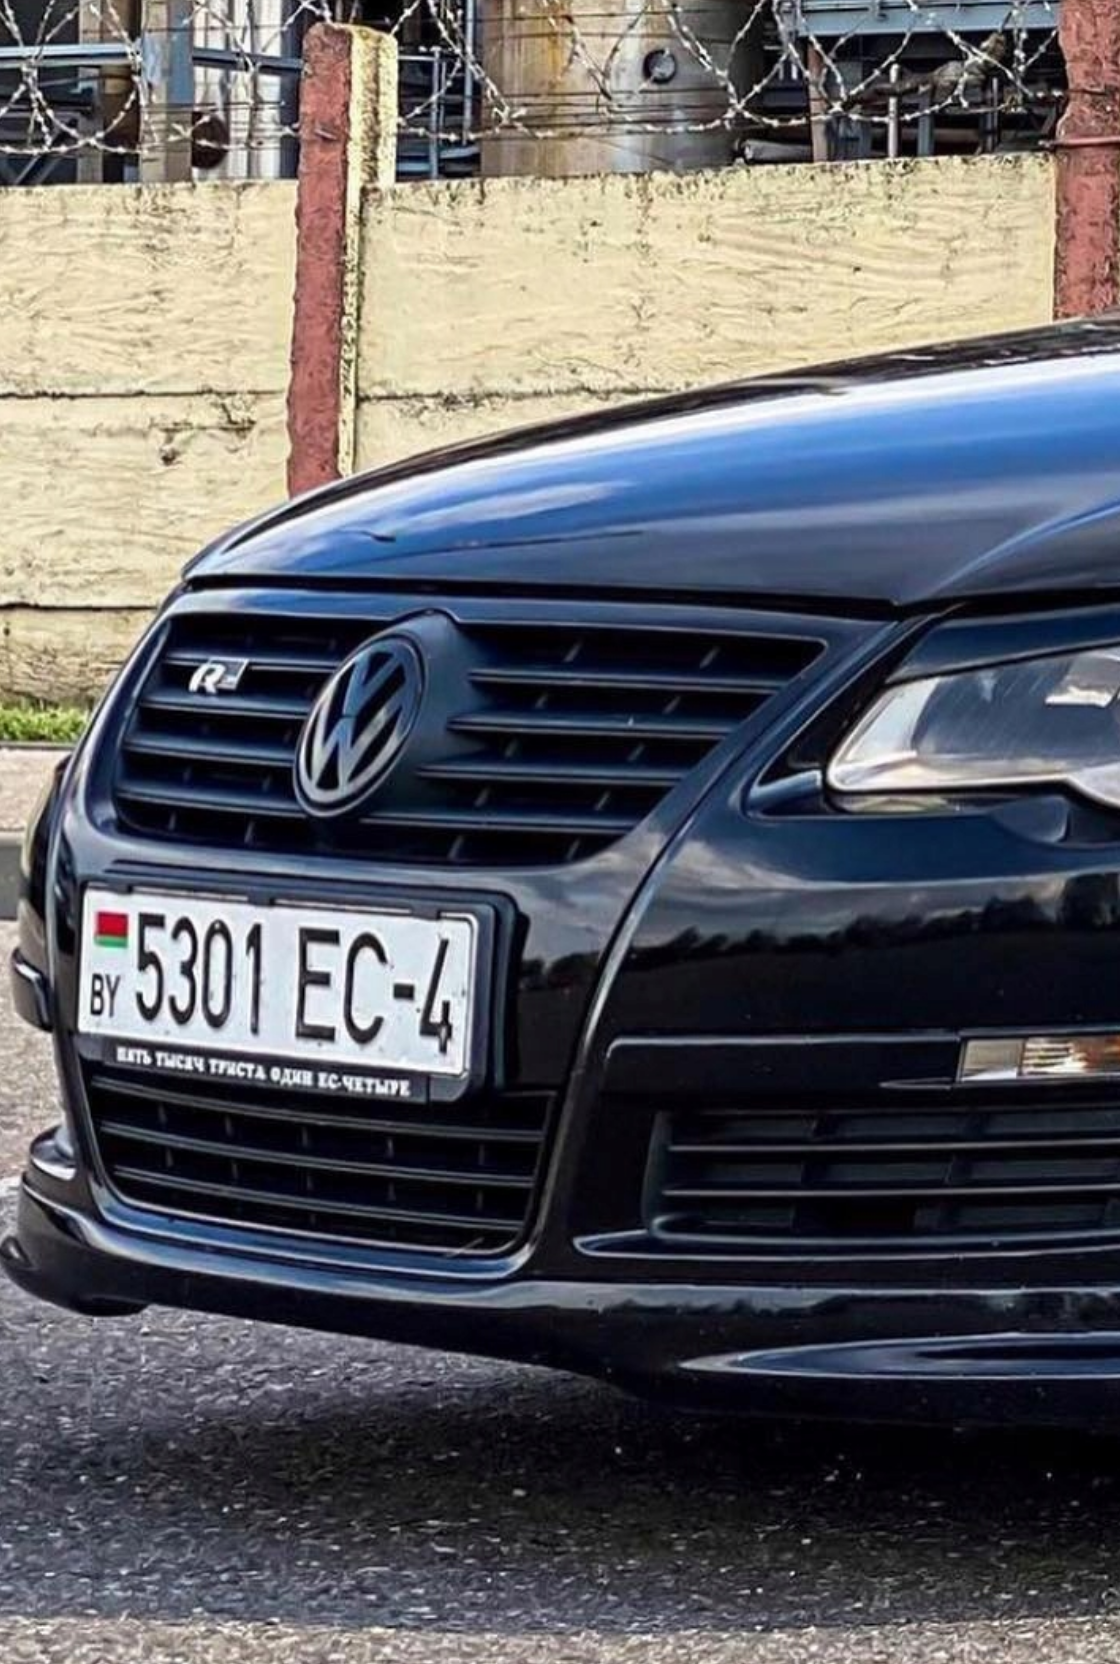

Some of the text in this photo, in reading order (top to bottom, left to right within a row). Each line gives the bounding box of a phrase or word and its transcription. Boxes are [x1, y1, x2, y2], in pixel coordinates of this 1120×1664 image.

[90, 972, 121, 1019] BY
[135, 911, 453, 1055] 5301 EC-4
[116, 1046, 152, 1066] ПЯТЬ
[155, 1051, 205, 1073] ТЫСЯЧ
[208, 1057, 267, 1081] ТРИСТА
[270, 1066, 313, 1087] ОДИН
